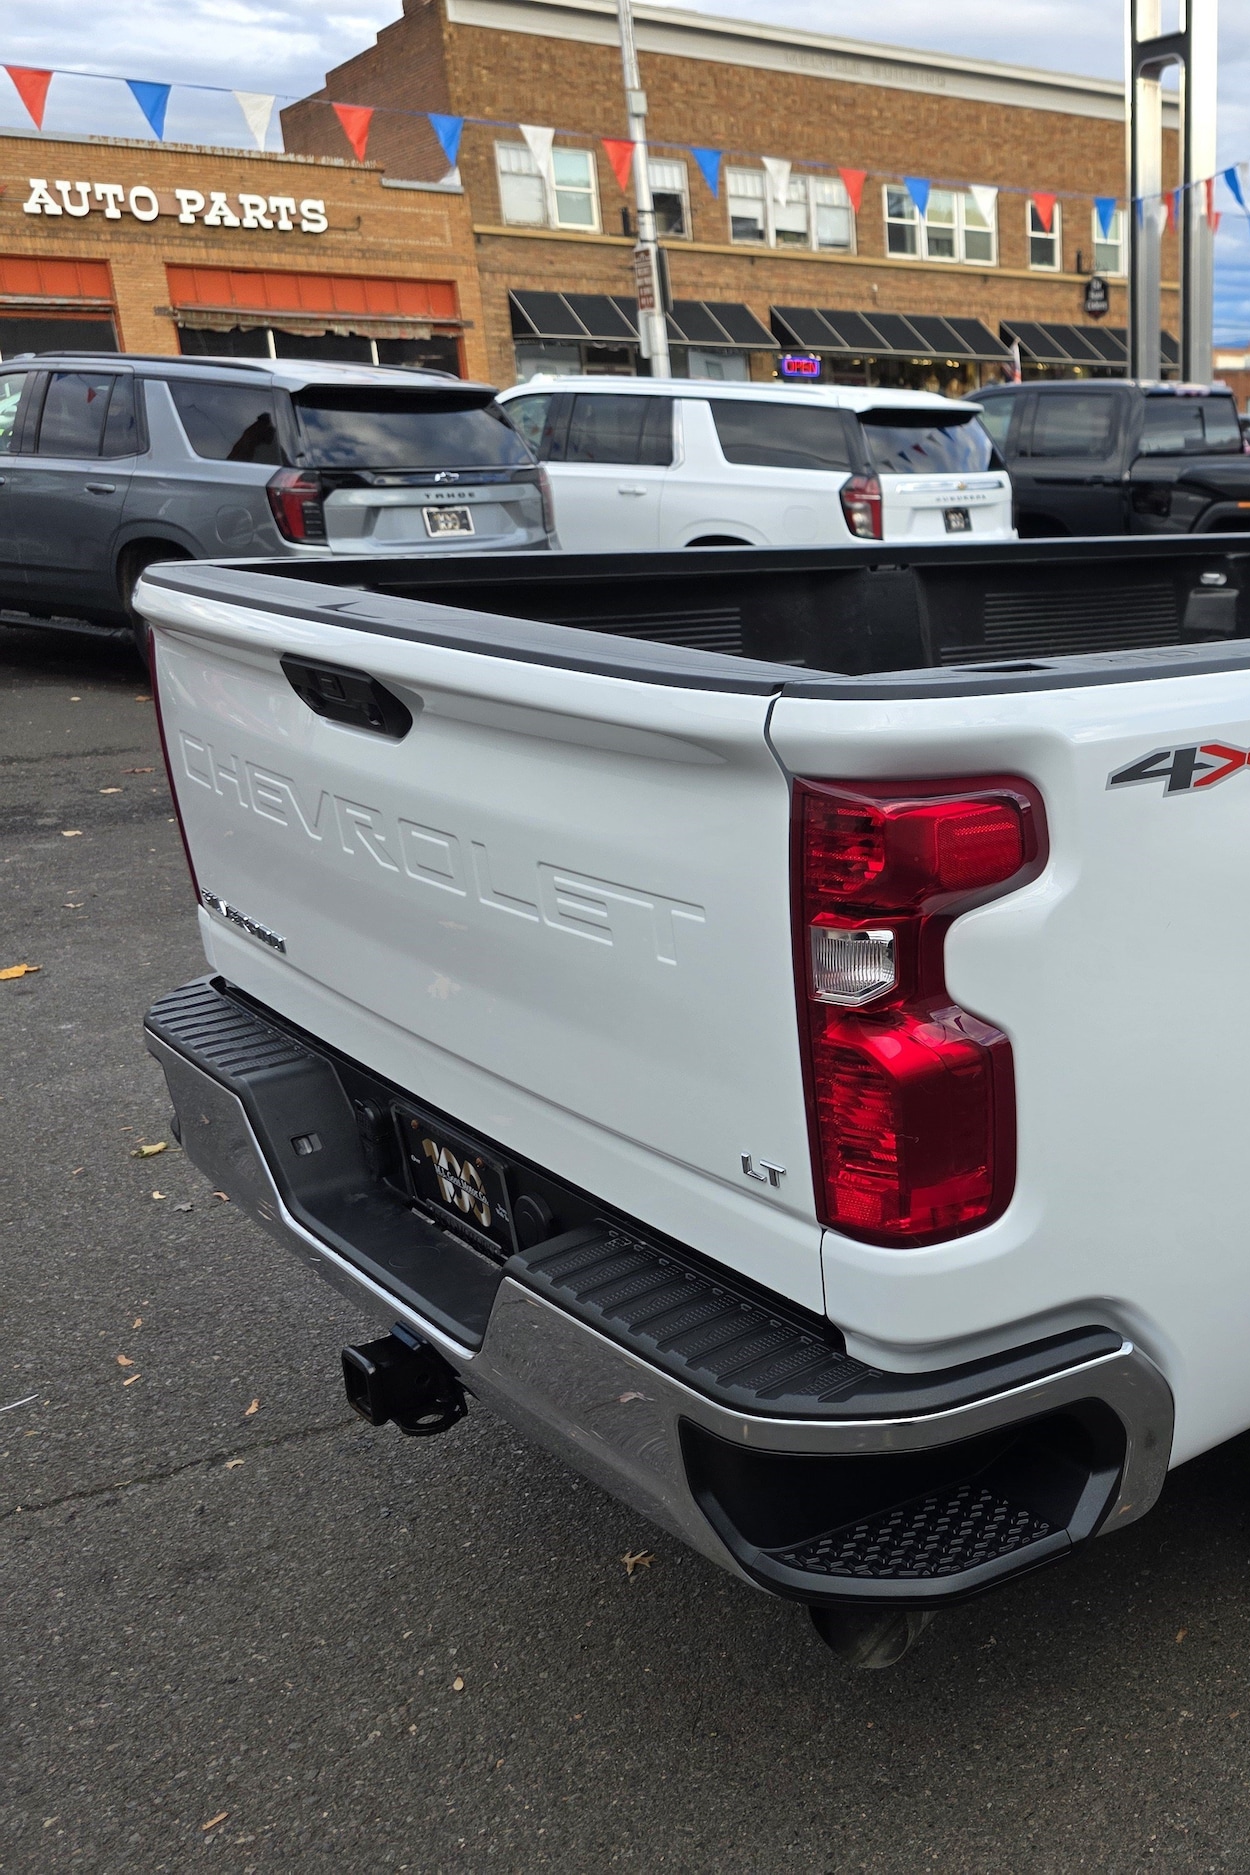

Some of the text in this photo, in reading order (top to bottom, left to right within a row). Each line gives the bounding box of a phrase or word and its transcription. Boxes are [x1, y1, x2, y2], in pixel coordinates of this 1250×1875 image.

[23, 178, 329, 233] AUTO PARTS
[785, 359, 818, 375] OPEN
[179, 729, 707, 966] CHEVROLET
[741, 1152, 787, 1189] LT
